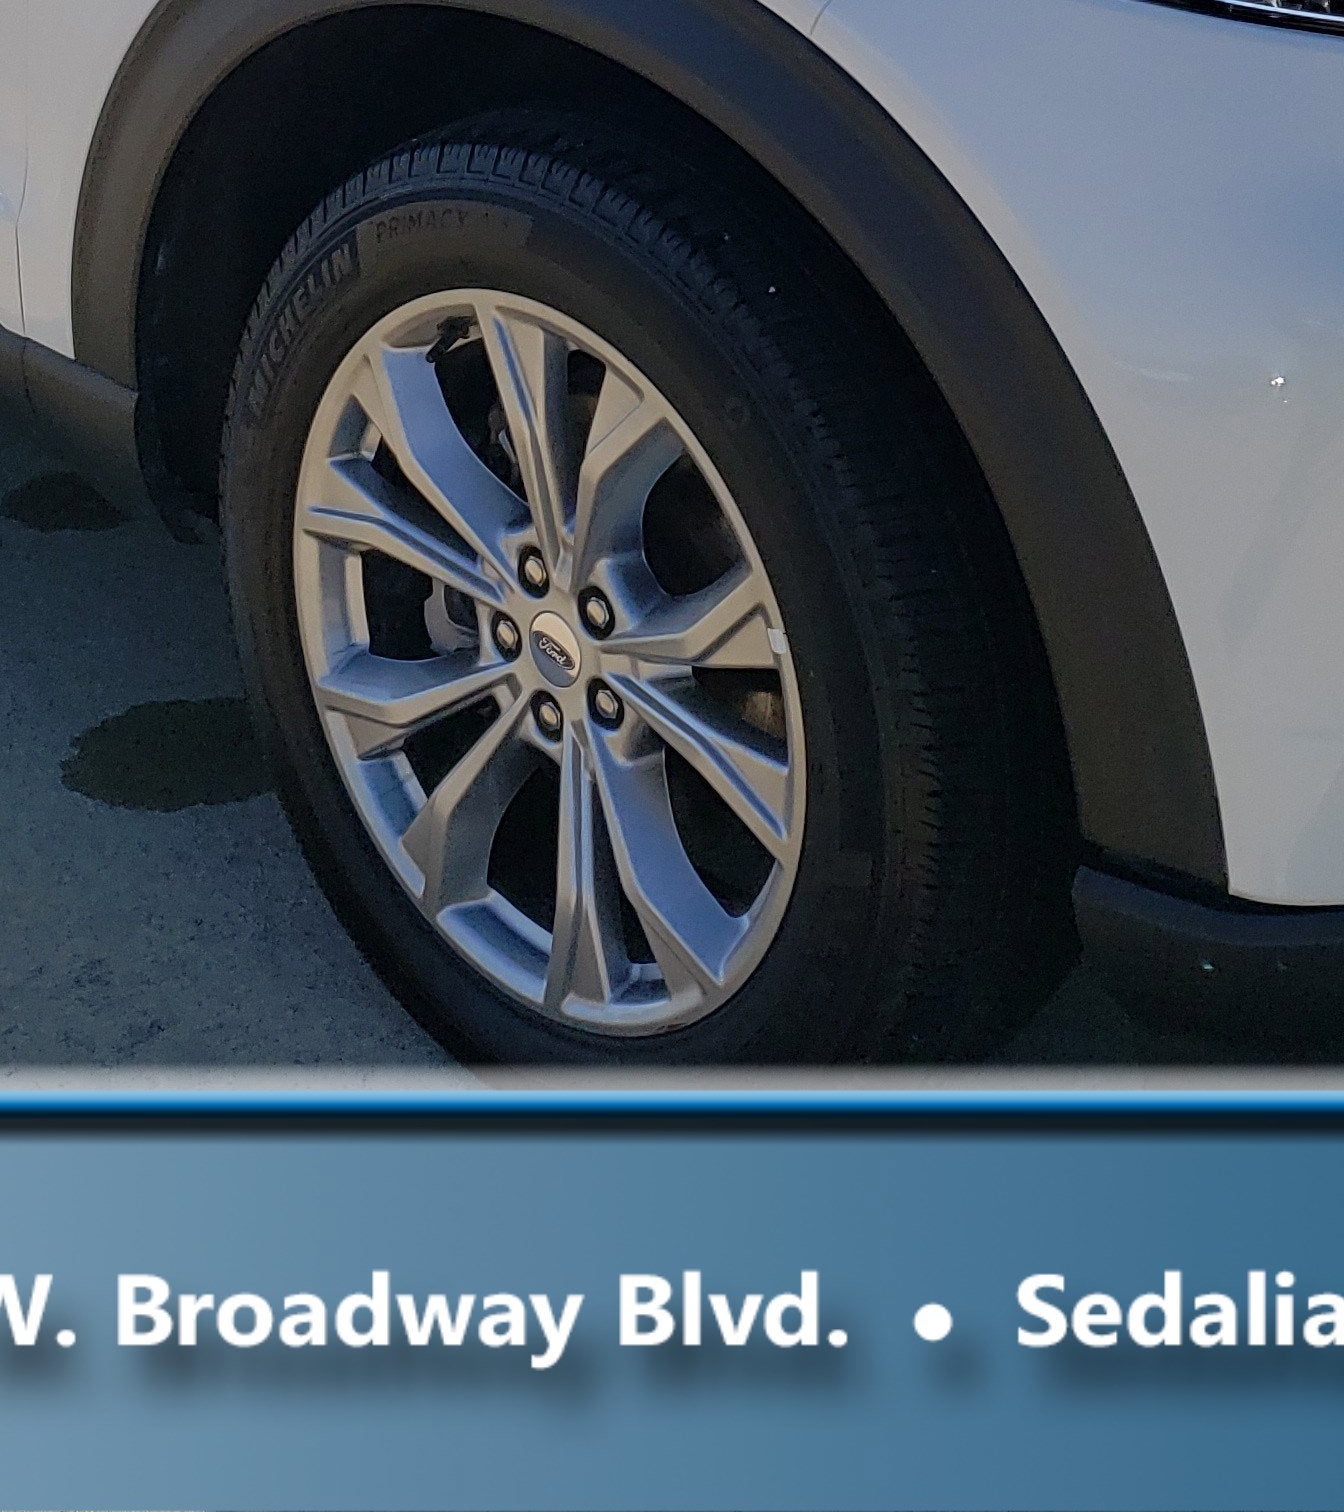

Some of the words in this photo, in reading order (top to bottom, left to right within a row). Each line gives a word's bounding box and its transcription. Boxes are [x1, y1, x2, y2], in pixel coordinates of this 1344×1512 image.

[375, 207, 468, 244] PRIMACY
[247, 242, 354, 419] MICHELIN
[538, 636, 567, 666] Ford
